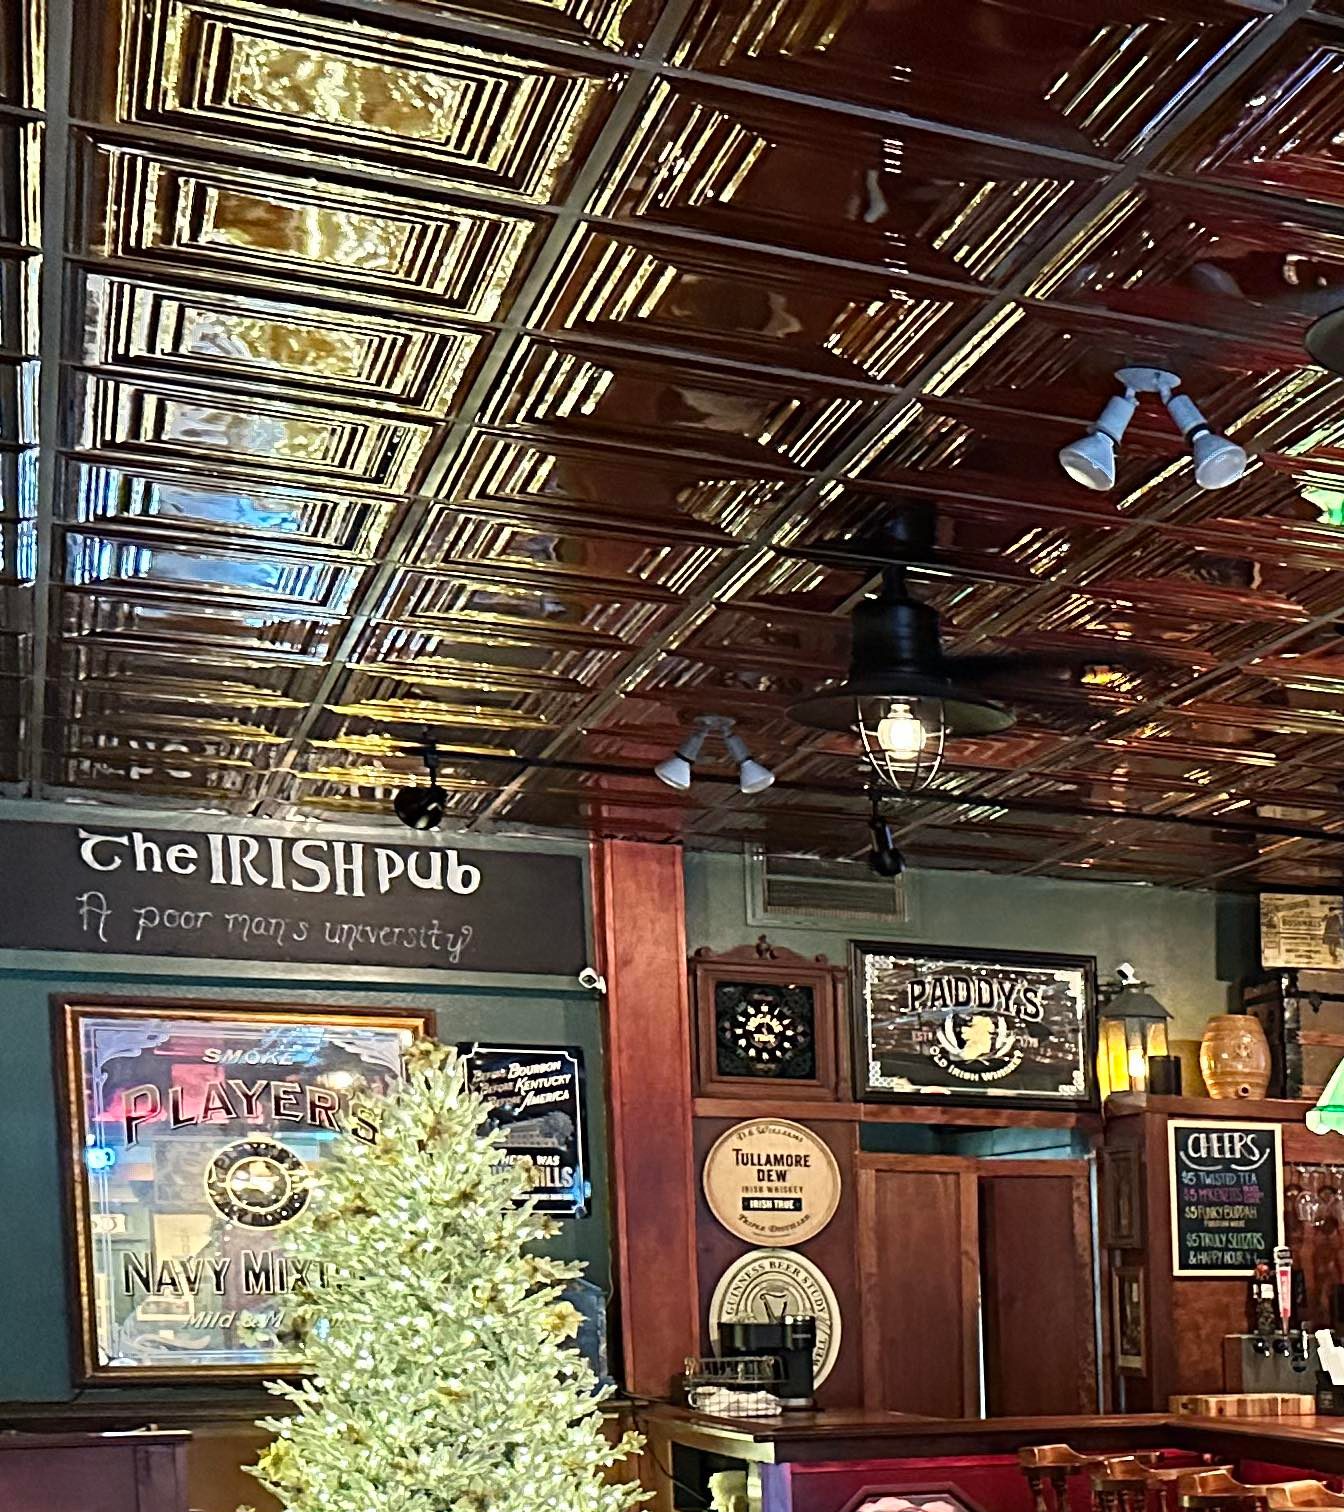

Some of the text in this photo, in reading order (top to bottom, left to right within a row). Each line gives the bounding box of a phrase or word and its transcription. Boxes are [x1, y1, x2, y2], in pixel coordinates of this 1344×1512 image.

[77, 828, 199, 875] The
[207, 833, 366, 897] IRISH
[75, 891, 113, 943] A
[134, 903, 213, 942] poor
[900, 974, 1044, 1022] PADDY'S
[202, 1048, 296, 1066] SMOKE
[929, 1045, 949, 1068] OLD
[514, 1074, 571, 1095] KENTUCKY
[732, 1148, 811, 1168] TULLAMORE
[1187, 1131, 1260, 1161] CHEERS
[756, 1168, 787, 1182] DEW
[121, 1250, 334, 1296] NAVY MIXT
[725, 1261, 826, 1315] GUINNESS BEER STUDY
